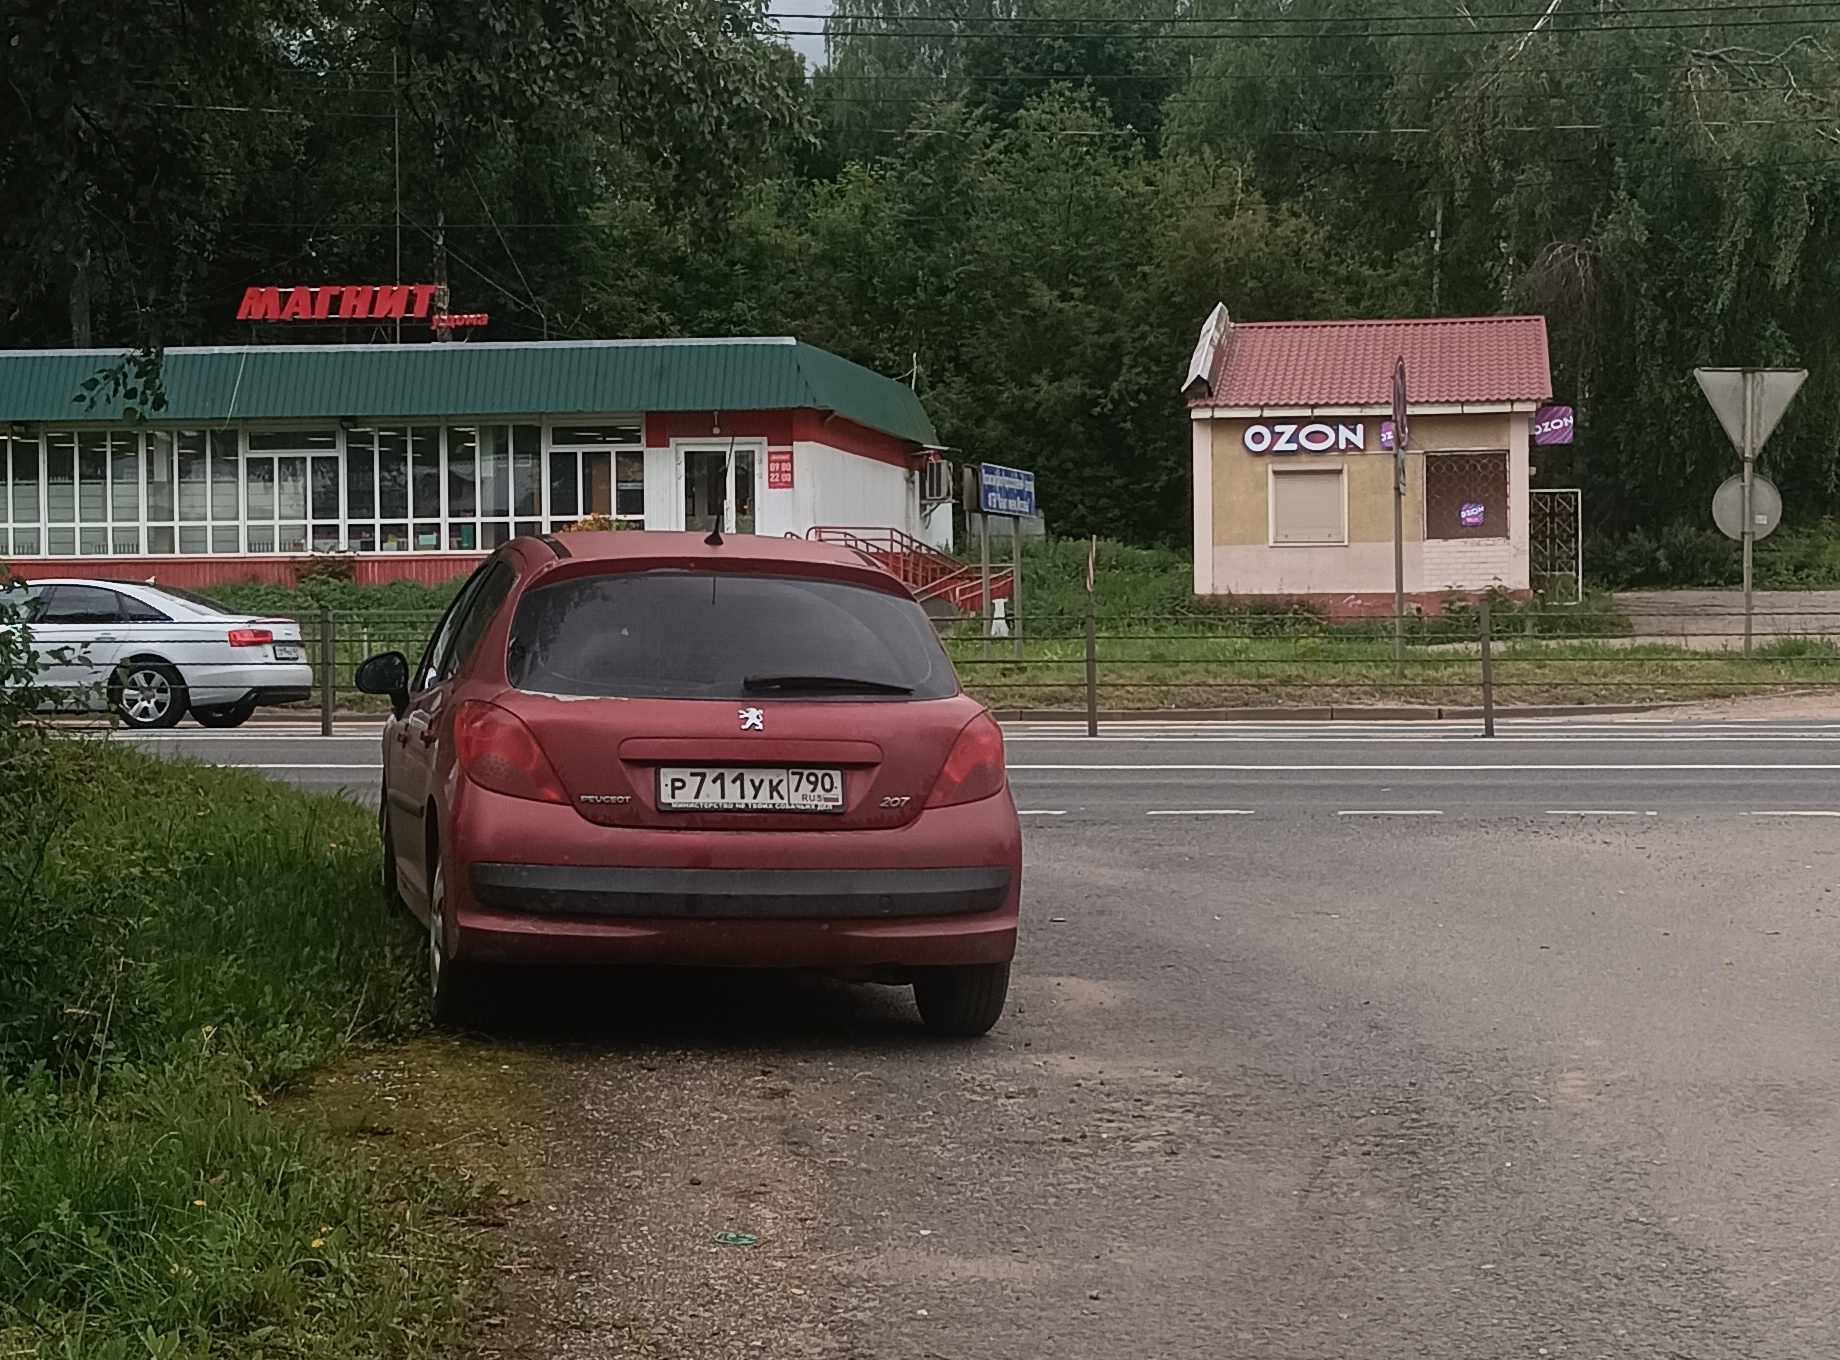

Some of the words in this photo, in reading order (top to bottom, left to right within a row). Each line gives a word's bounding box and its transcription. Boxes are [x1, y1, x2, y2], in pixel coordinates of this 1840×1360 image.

[236, 285, 436, 320] МАГНИТ
[1244, 423, 1364, 452] OZON
[670, 771, 785, 801] Р711УК
[791, 771, 834, 793] 790
[580, 795, 632, 803] PEUGEOT
[801, 793, 823, 803] RUS
[879, 796, 911, 807] 207
